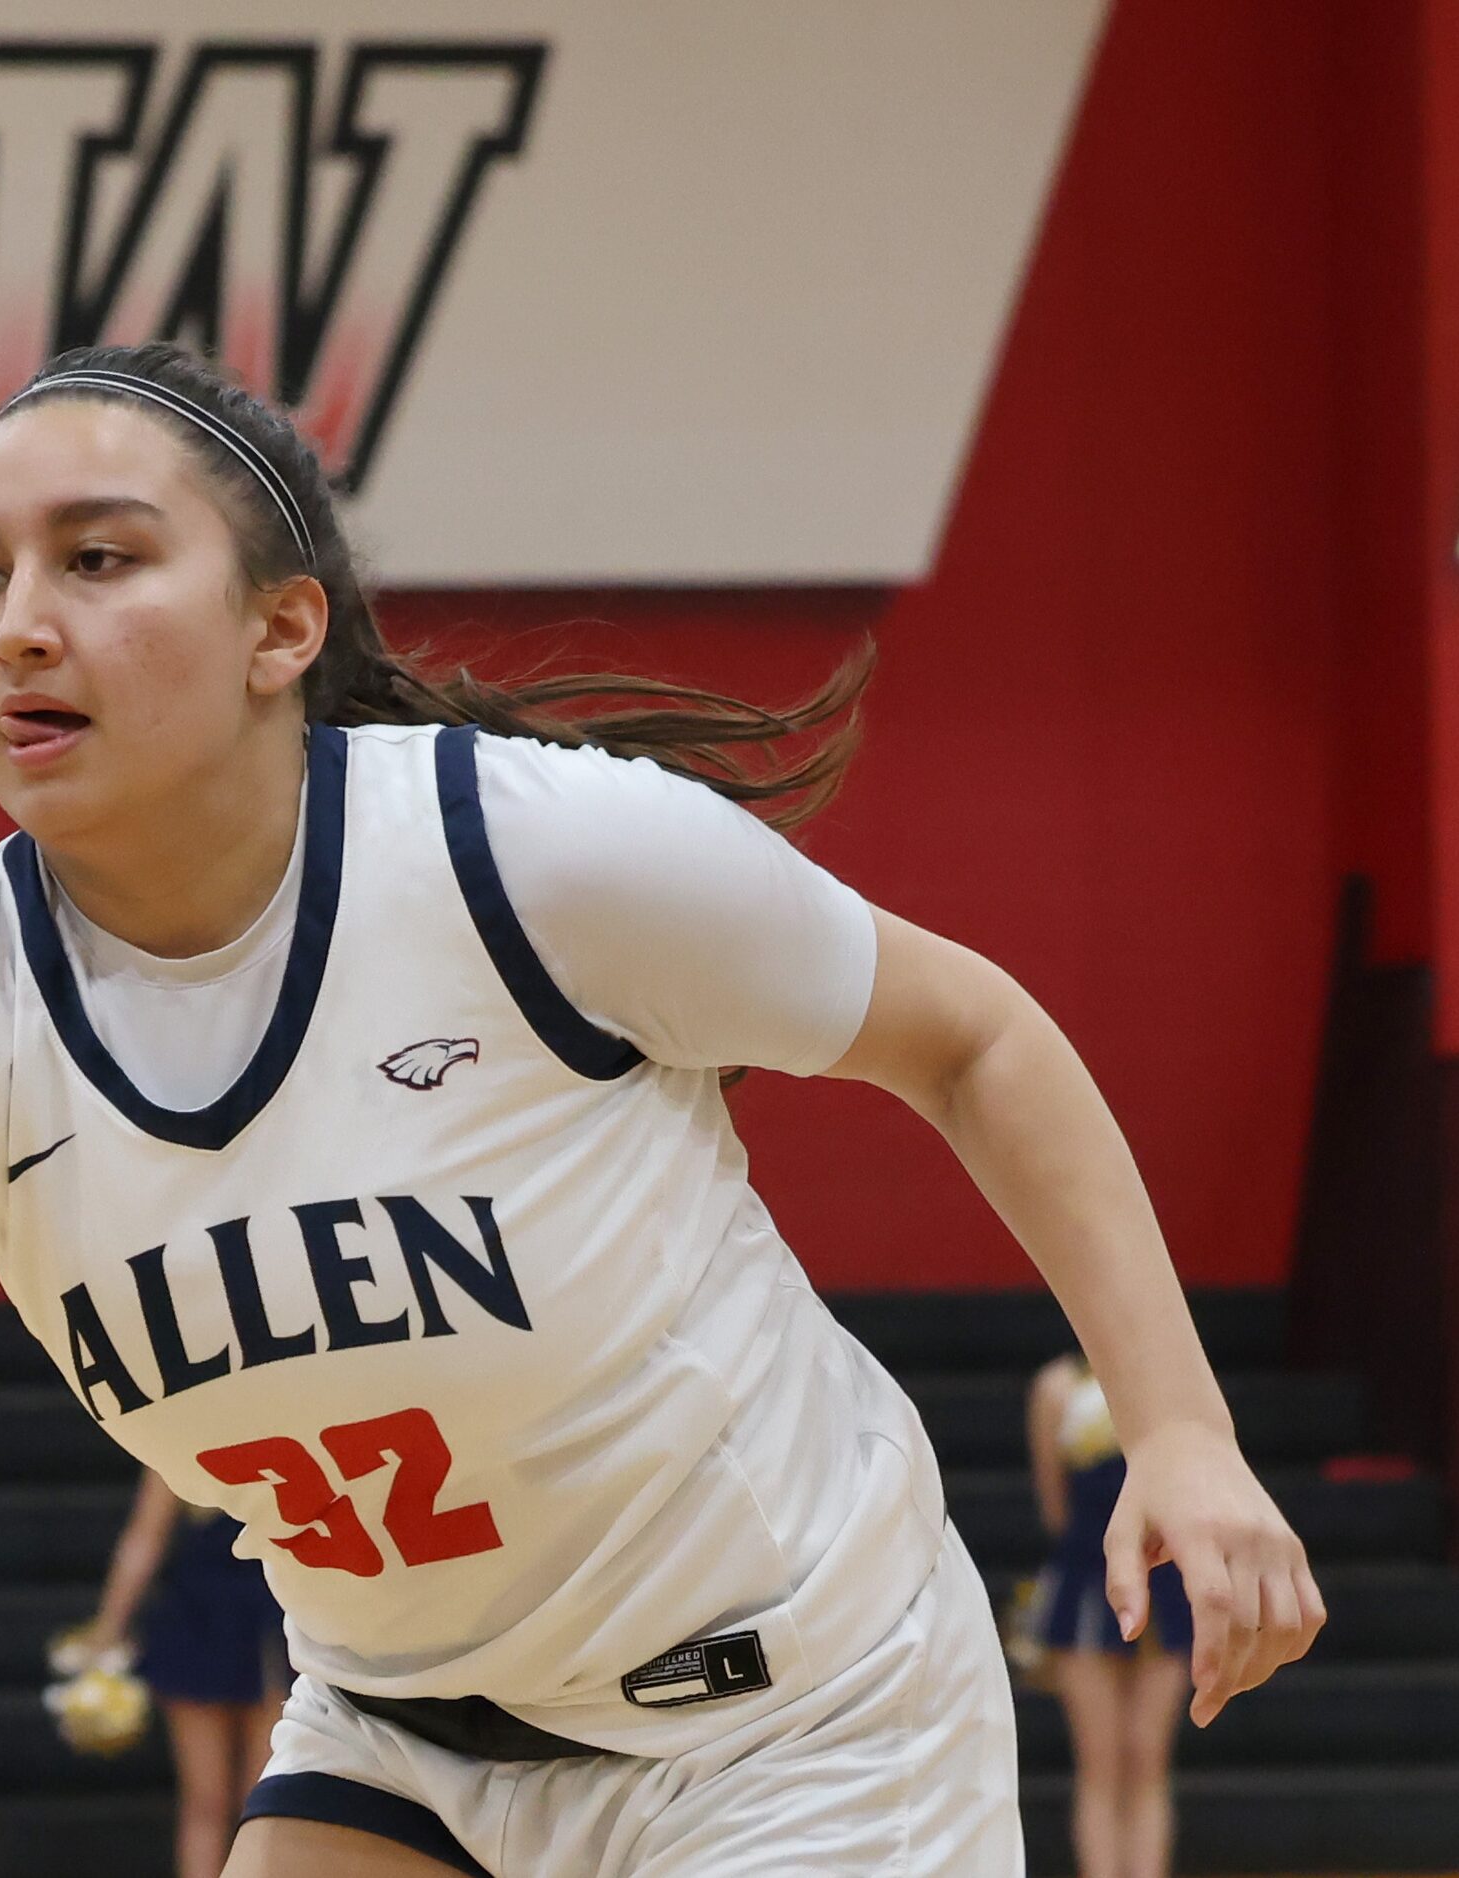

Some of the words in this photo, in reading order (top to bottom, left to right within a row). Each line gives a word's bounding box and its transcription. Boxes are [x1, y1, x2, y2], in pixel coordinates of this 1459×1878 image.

[59, 1195, 534, 1422] ALLEN
[196, 1407, 504, 1577] 32
[722, 1657, 744, 1680] L
